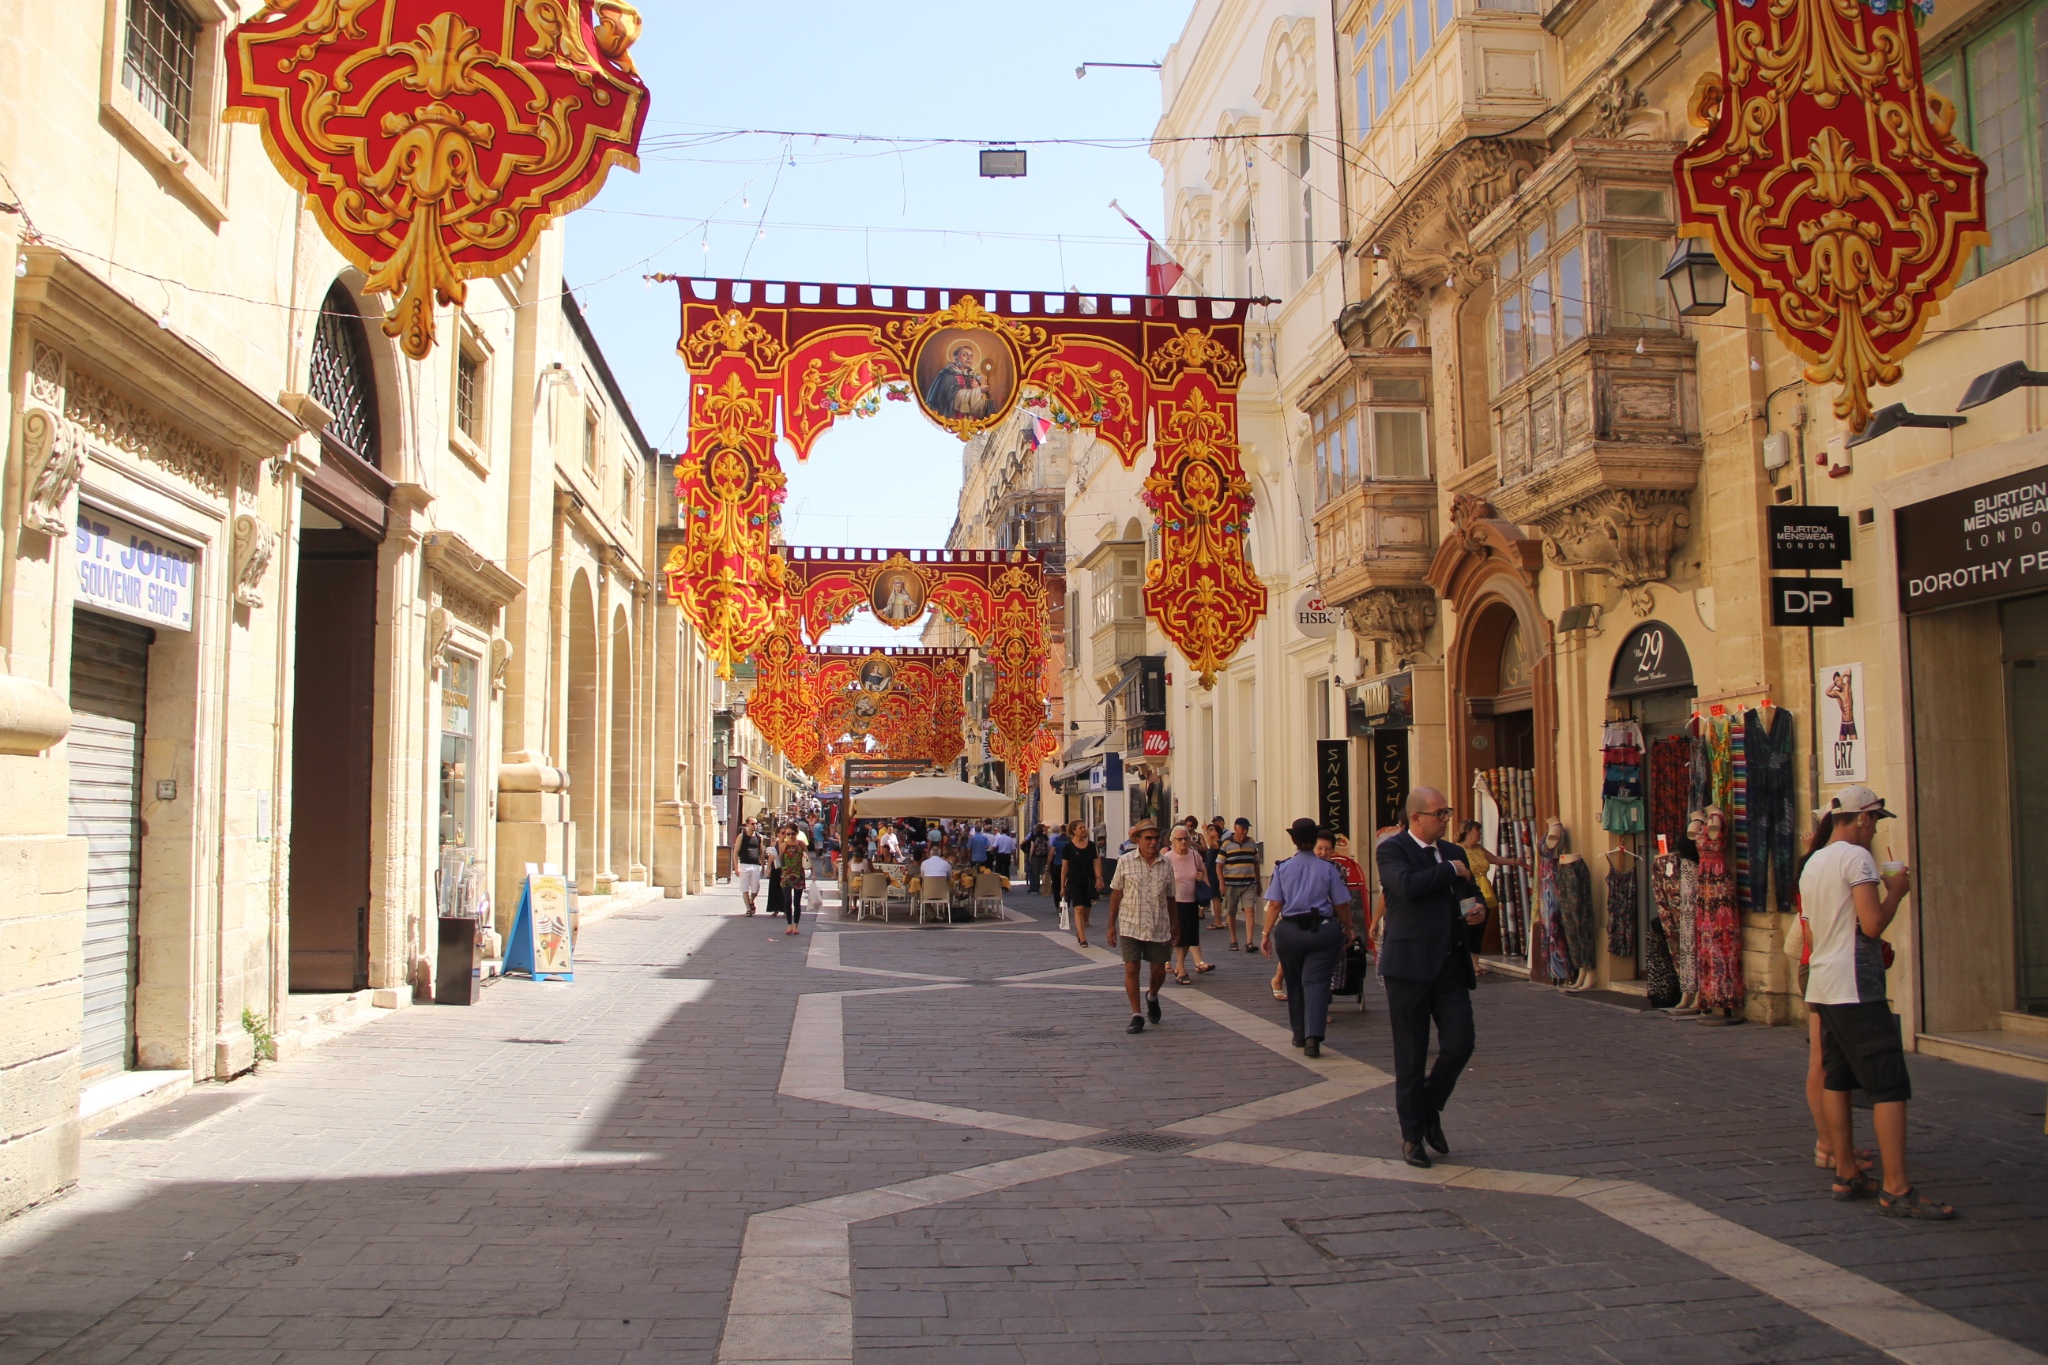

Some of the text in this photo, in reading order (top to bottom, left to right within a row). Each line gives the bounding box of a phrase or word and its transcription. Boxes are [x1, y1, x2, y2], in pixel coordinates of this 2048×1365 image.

[1963, 497, 2048, 533] MENSWEA
[1974, 481, 2047, 515] BURTON
[1776, 532, 1835, 541] MENSWEAR
[1777, 542, 1836, 550] LONDON
[1783, 525, 1828, 534] BURTON
[76, 514, 188, 588] ST. JOHN
[80, 559, 178, 618] SOUVENIR SHOP
[1909, 558, 2012, 597] DOROTHY
[1299, 611, 1338, 624] HSBC
[1783, 590, 1833, 614] DP
[1637, 629, 1664, 672] 29
[1145, 734, 1169, 754] illy
[1834, 741, 1853, 769] CR7
[1326, 748, 1341, 831] SNACKS
[1383, 744, 1401, 820] SUSHI
